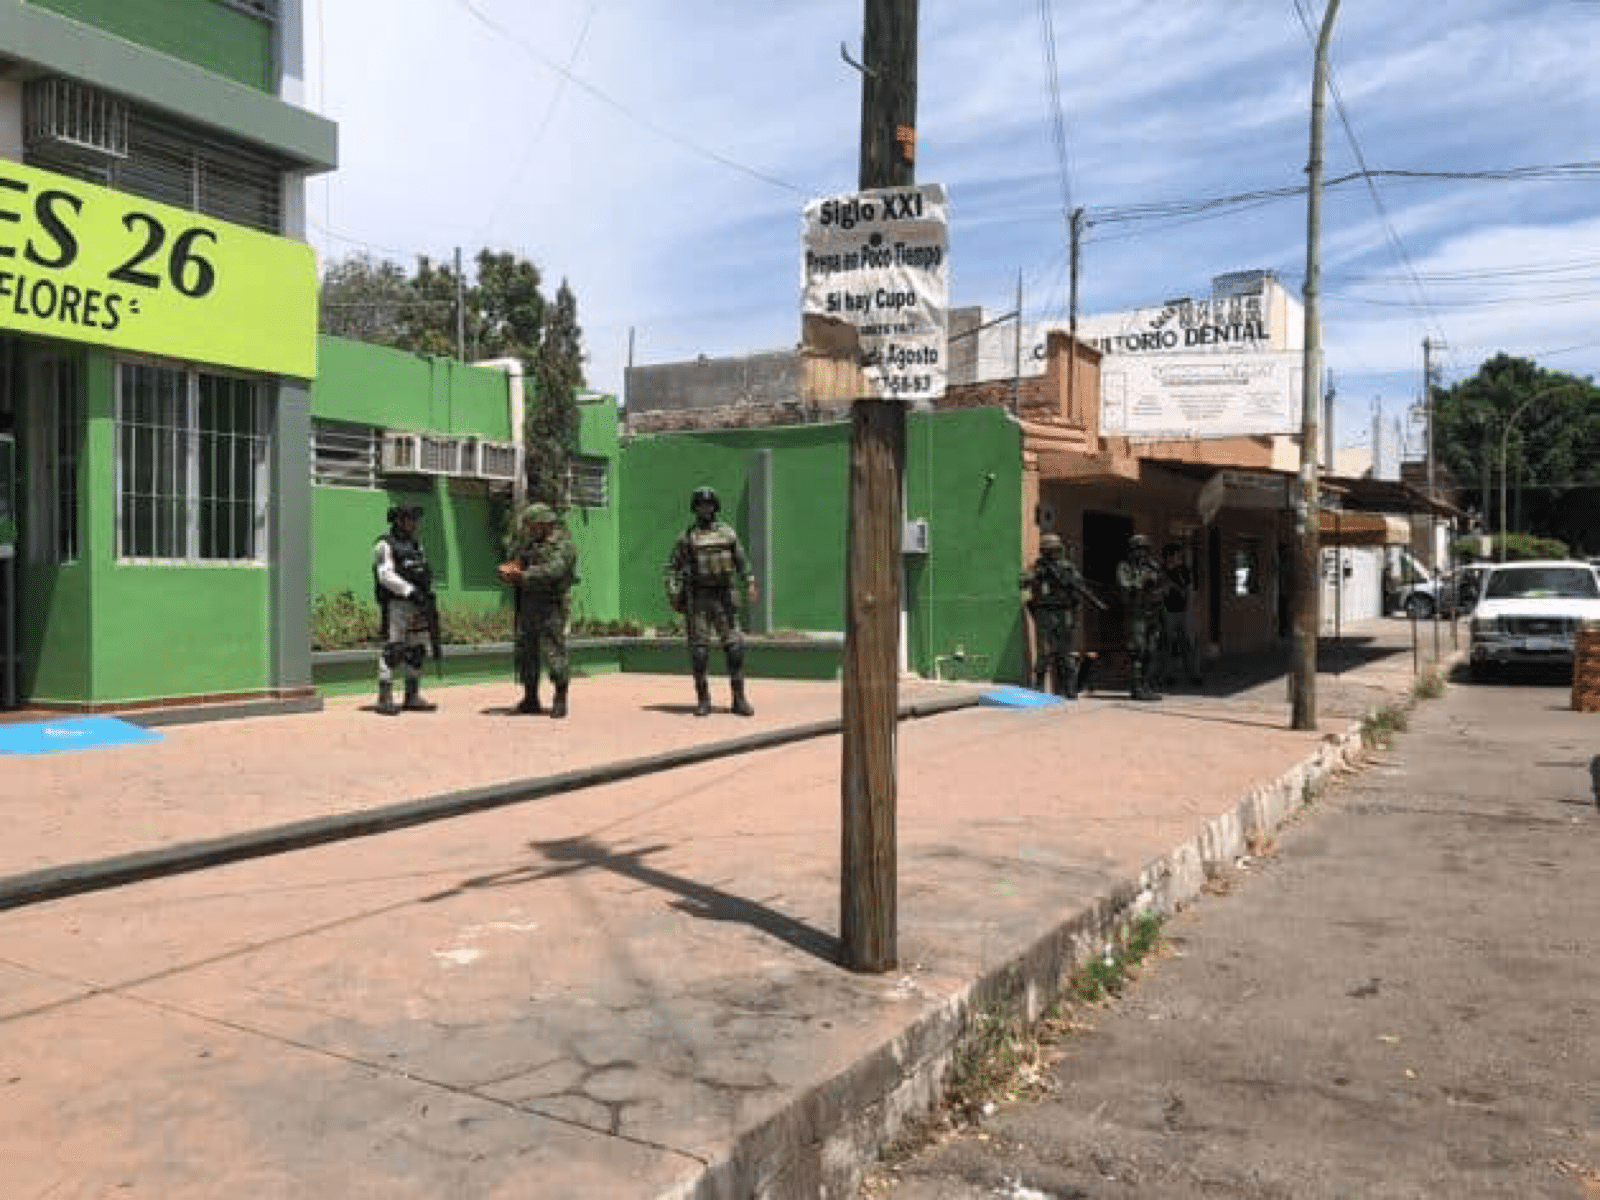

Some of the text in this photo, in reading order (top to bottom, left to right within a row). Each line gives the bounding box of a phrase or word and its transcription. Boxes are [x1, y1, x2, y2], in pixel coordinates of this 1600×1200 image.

[820, 192, 922, 230] Siglo XXI
[107, 212, 218, 299] 26
[876, 287, 915, 313] Cupo
[886, 343, 938, 370] Agosto
[1030, 319, 1271, 361] CULTORIO DENTAL
